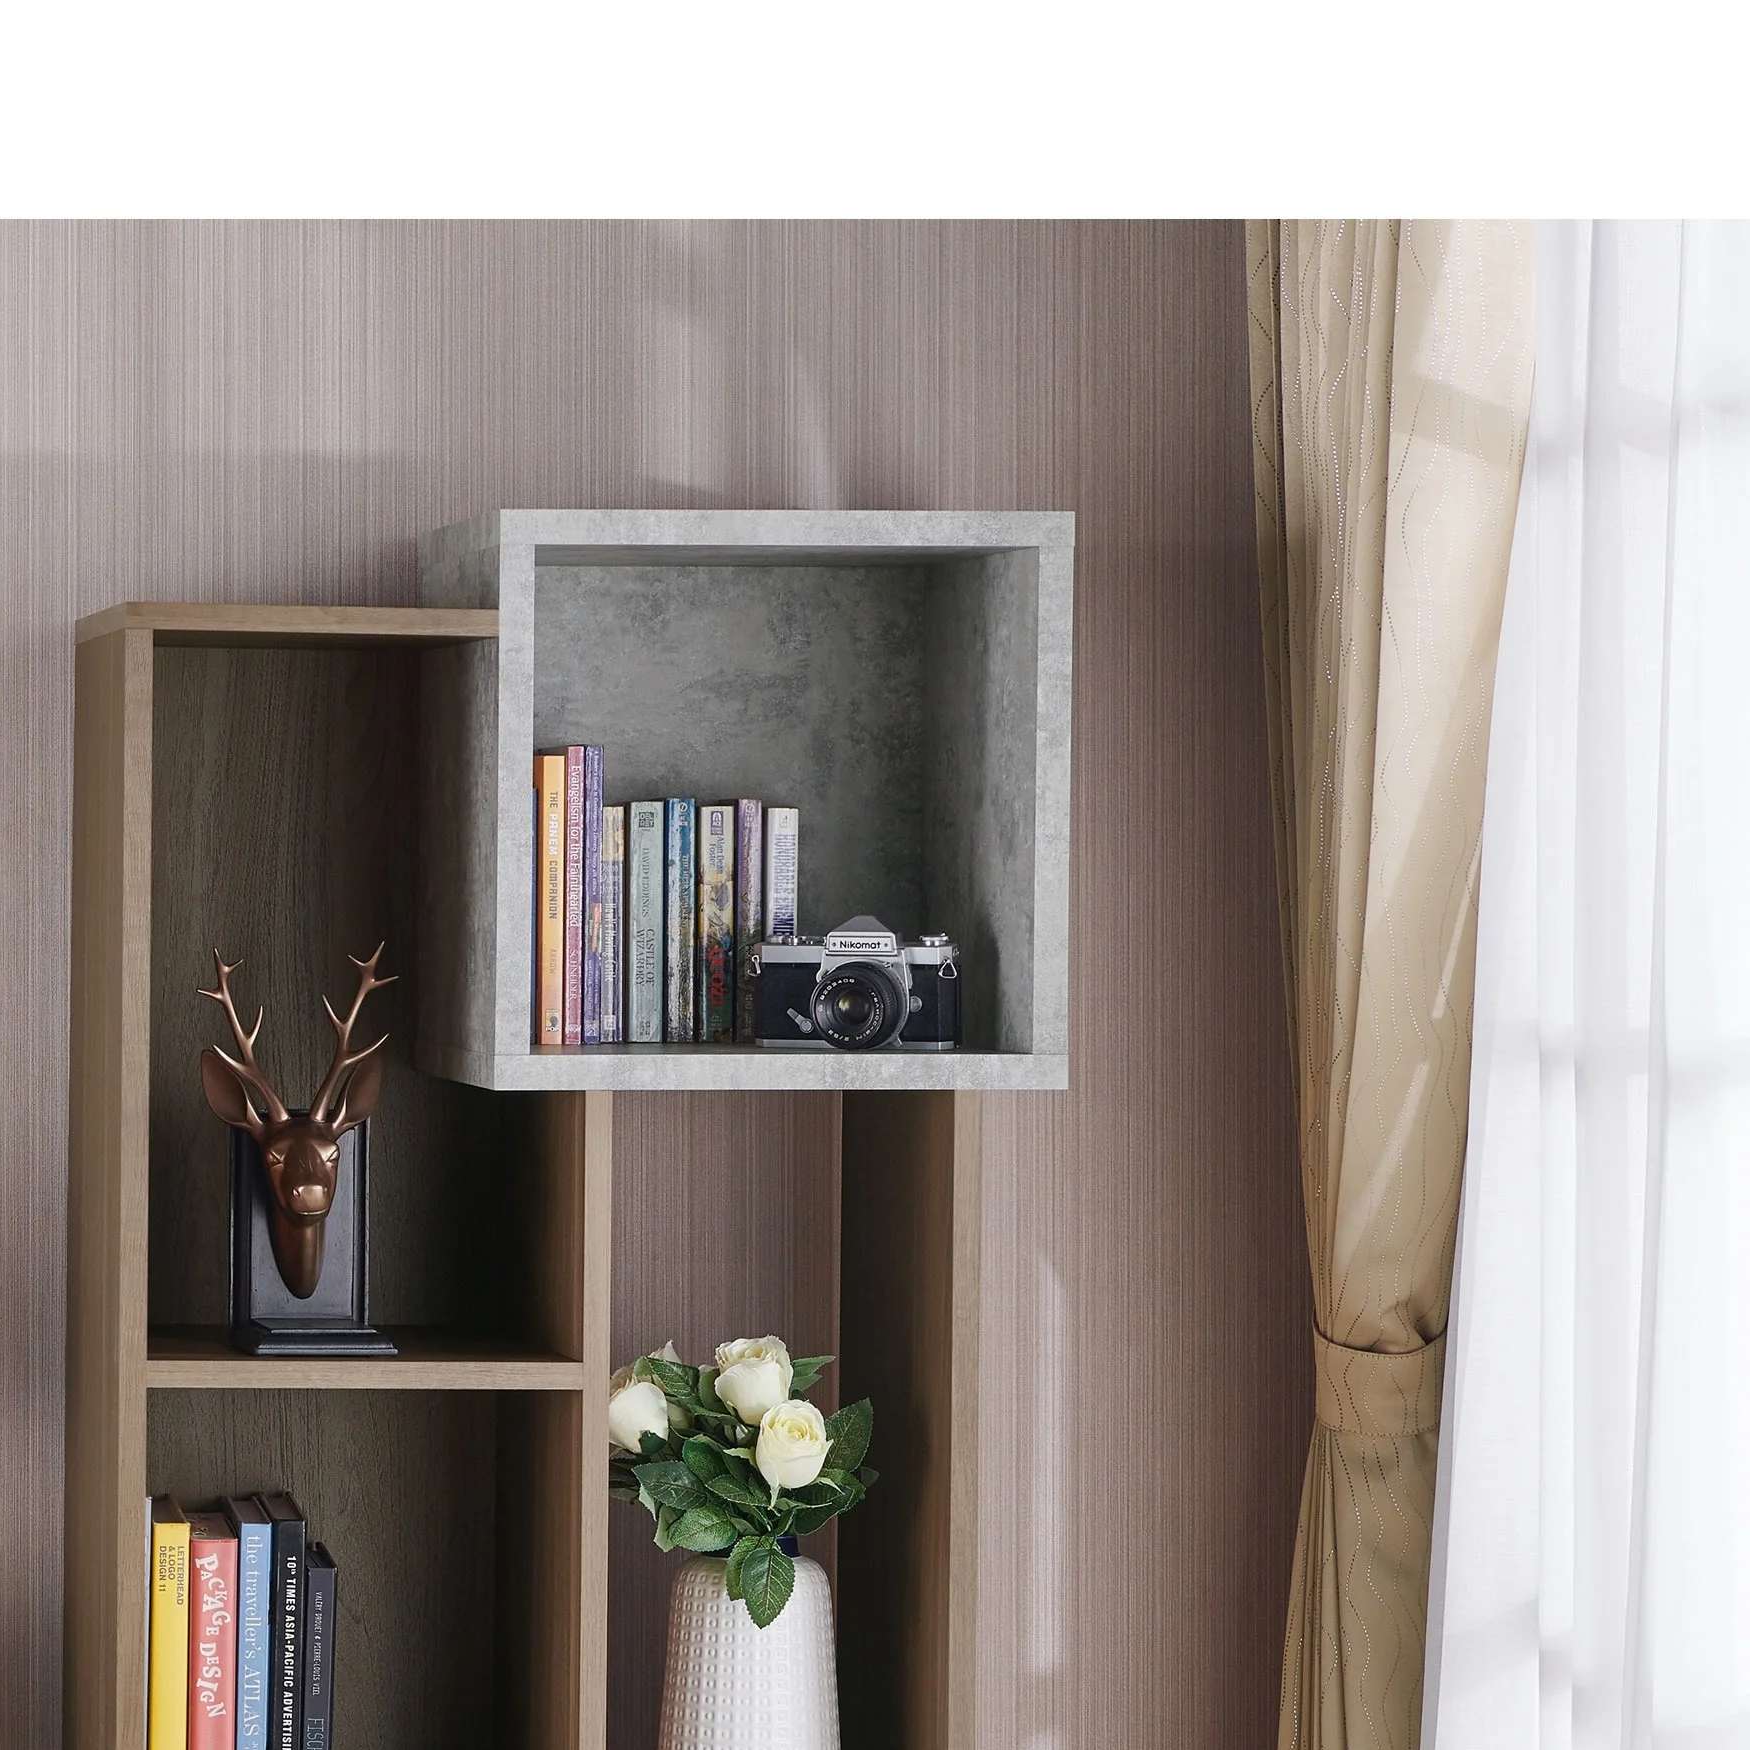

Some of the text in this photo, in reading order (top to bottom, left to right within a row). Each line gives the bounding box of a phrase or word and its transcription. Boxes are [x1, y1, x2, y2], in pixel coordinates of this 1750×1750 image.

[550, 791, 558, 808] THE
[569, 765, 581, 927] Evangelism for the Fainthearted
[716, 836, 724, 854] Alan
[774, 834, 796, 894] HONORABLE
[549, 860, 558, 919] COMPANION
[642, 848, 650, 917] DAVID EDDINGS
[602, 903, 616, 982] Howl's Moving Castle
[772, 897, 794, 936] ENEMIE
[840, 940, 881, 950] Nikomat
[570, 949, 578, 1000] SCHNEIDER
[636, 928, 645, 987] WIZARDRY
[646, 928, 655, 986] CASTLE OF
[176, 1546, 184, 1605] LETTERHEAD
[194, 1553, 231, 1636] PACKAGE
[286, 1556, 296, 1574] 10th
[286, 1578, 296, 1611] TIMES
[243, 1536, 262, 1736] the traveller's ATLAS
[284, 1615, 294, 1687] ASIA-PACIFIC
[313, 1642, 322, 1681] PIERRE-LOUIS
[196, 1642, 226, 1718] DESIGN
